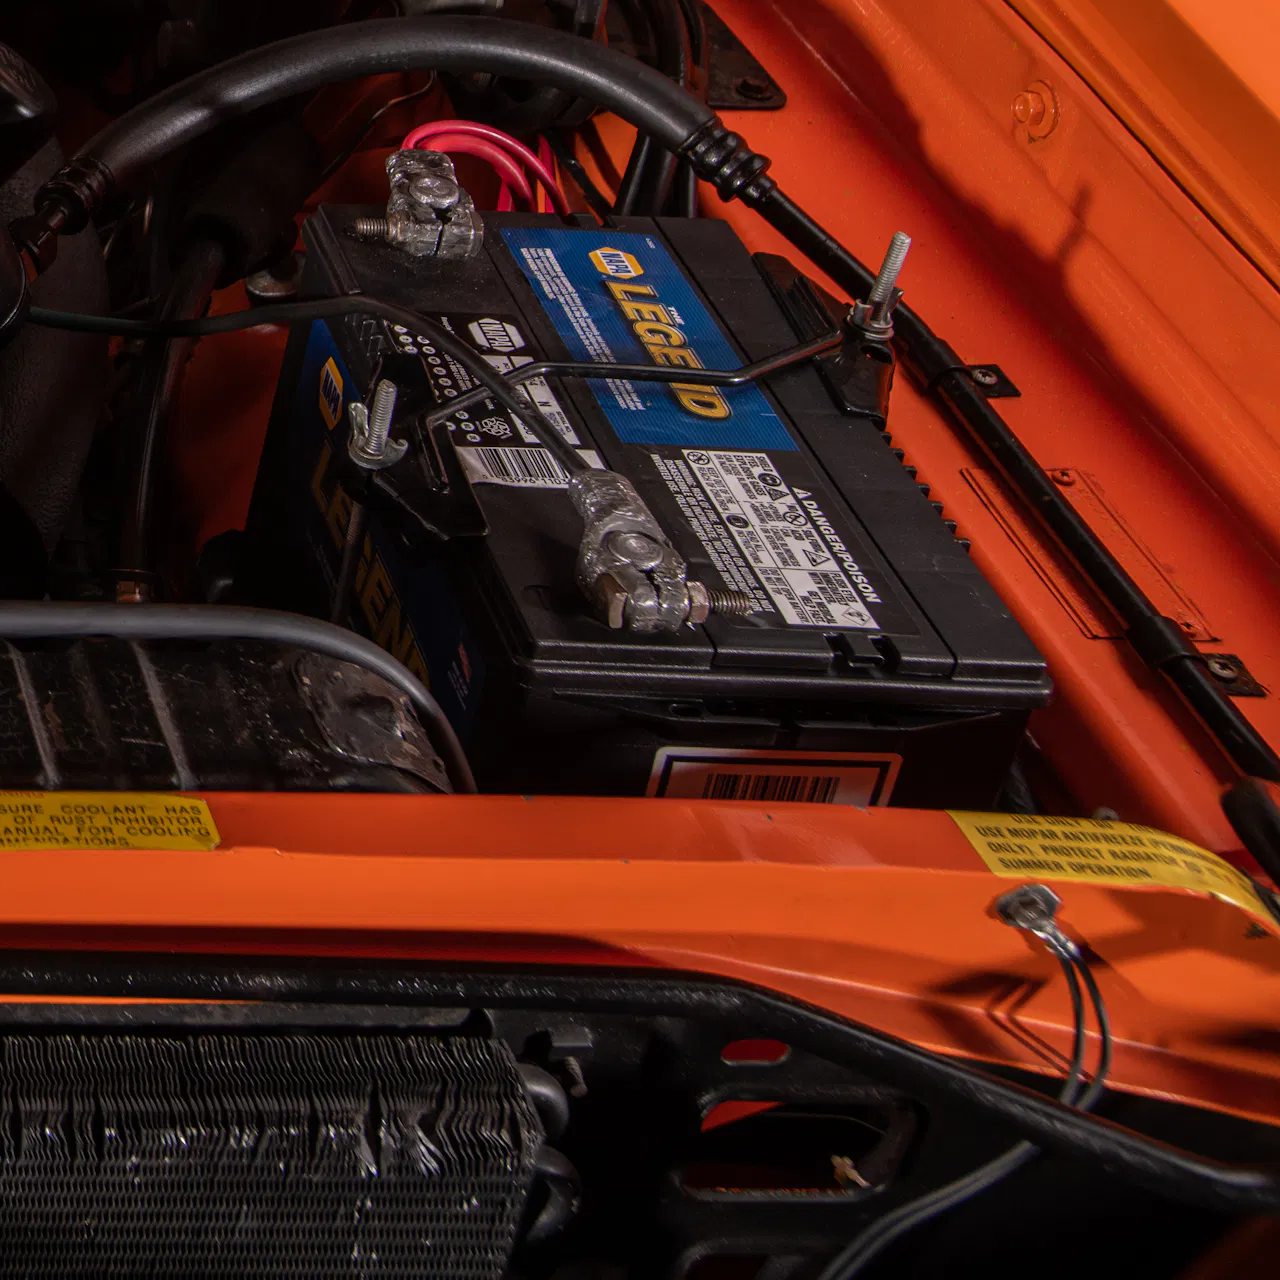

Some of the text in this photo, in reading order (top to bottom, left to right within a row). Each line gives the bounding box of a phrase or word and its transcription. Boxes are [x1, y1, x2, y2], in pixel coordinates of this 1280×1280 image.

[600, 251, 634, 276] NAPA
[480, 321, 511, 349] NAPA
[319, 366, 342, 418] NAPA
[800, 500, 881, 602] DANGER/POISON
[15, 816, 36, 825] OF
[50, 815, 96, 825] RUST
[61, 804, 146, 814] COOLANT
[166, 805, 202, 814] HAS
[77, 826, 114, 837] FOR
[126, 826, 210, 837] COOLING
[974, 825, 1005, 838] USE
[1005, 827, 1062, 841] MOPAR
[1060, 831, 1147, 848] ANTIFREEZE
[1039, 844, 1107, 860] PROTECT
[998, 857, 1153, 879] SUMMER OPERATION
